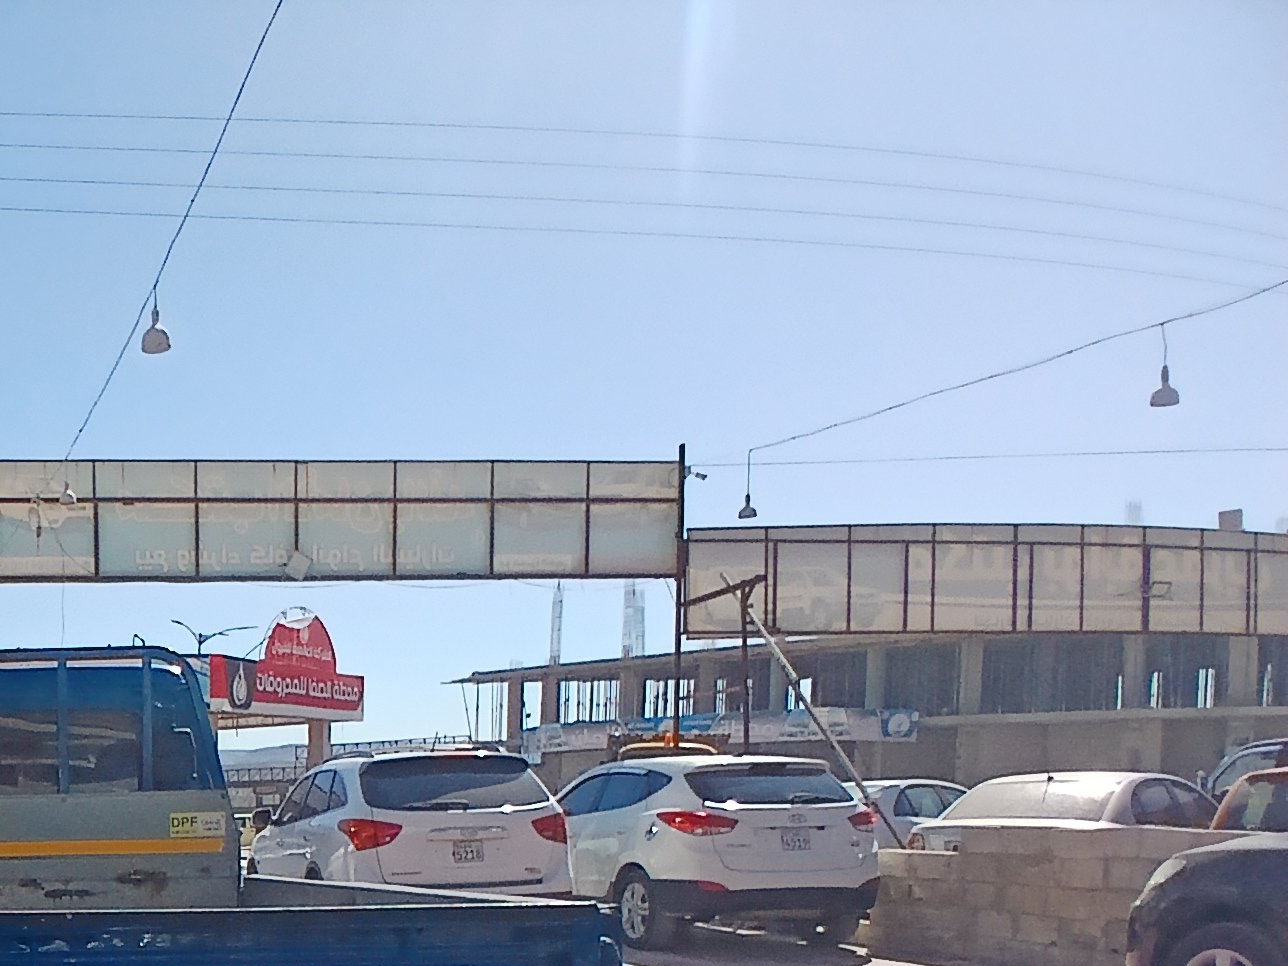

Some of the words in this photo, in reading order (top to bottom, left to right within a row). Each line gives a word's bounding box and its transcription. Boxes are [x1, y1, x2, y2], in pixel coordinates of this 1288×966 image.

[256, 671, 307, 699] للمحروقات
[307, 676, 332, 699] الصفا
[332, 680, 360, 701] محطة
[171, 816, 198, 828] DPF
